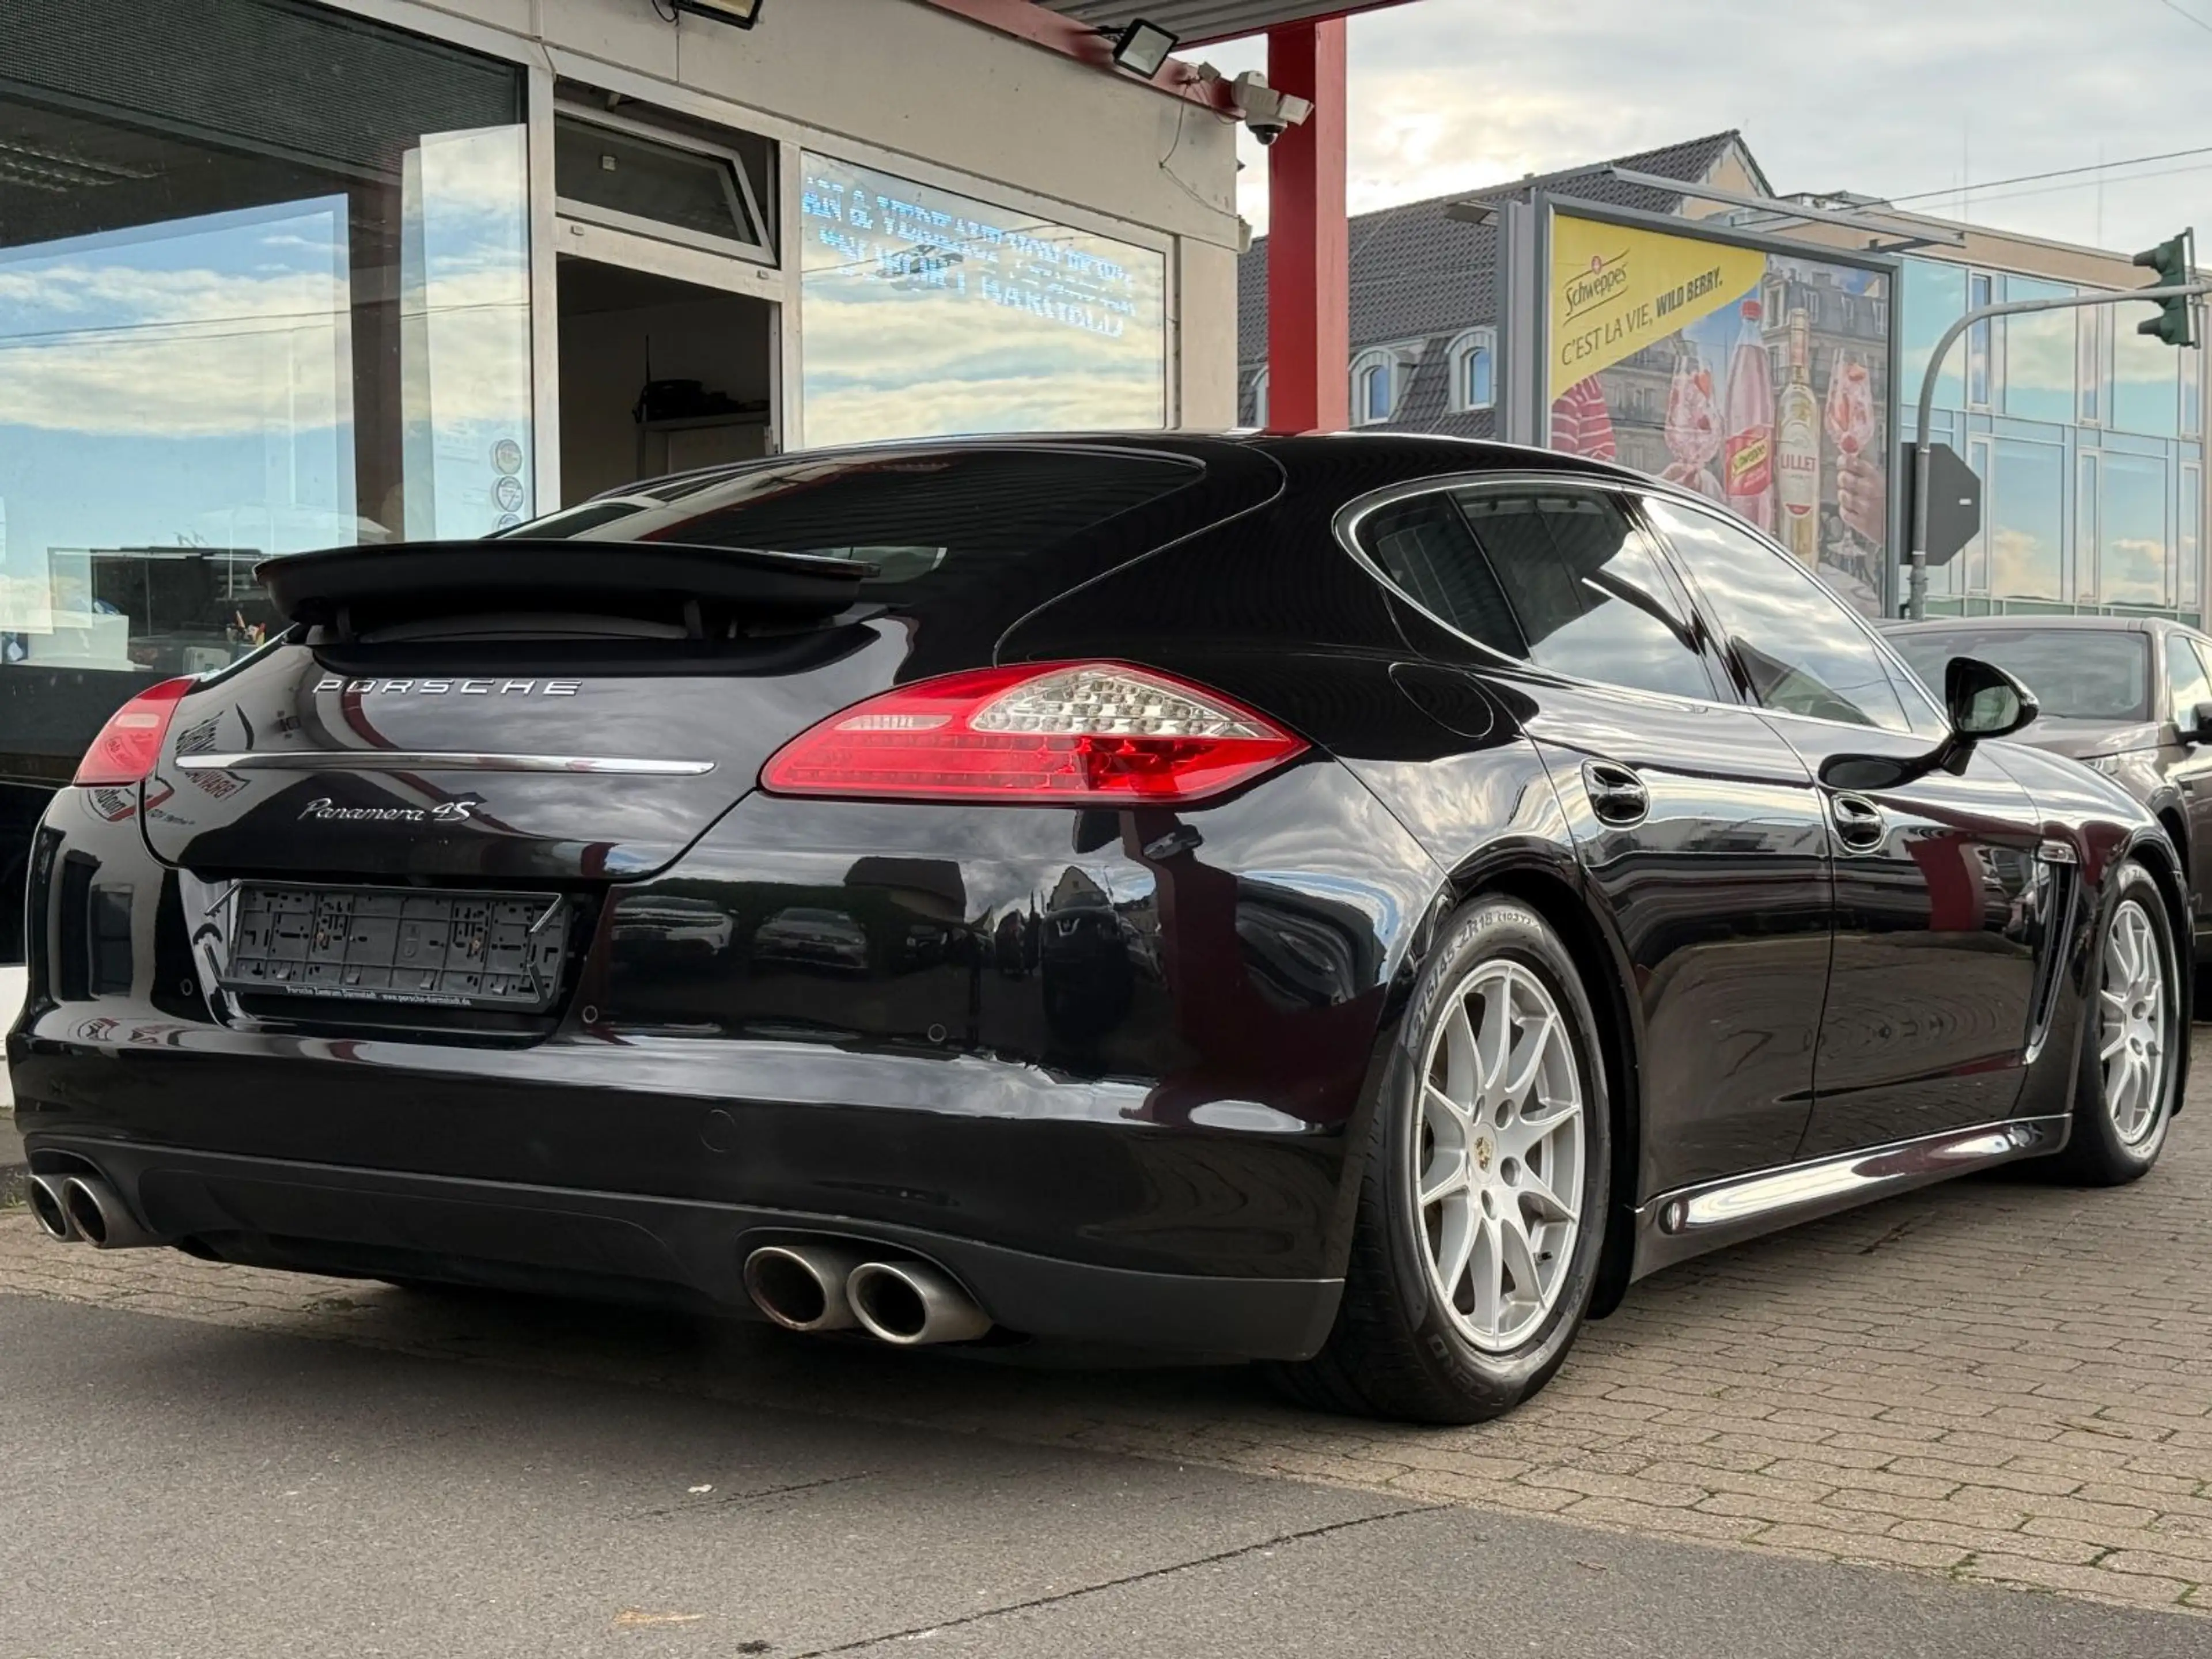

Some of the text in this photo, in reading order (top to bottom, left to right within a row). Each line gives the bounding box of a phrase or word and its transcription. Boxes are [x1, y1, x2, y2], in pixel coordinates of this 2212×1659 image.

[1565, 264, 1627, 316] Schweppes
[1562, 266, 1723, 366] C'EST LA VIE, WILD BERRY.
[1781, 453, 1816, 472] LILLET
[312, 679, 582, 696] PORSCHE
[298, 798, 476, 823] Panamera 4S
